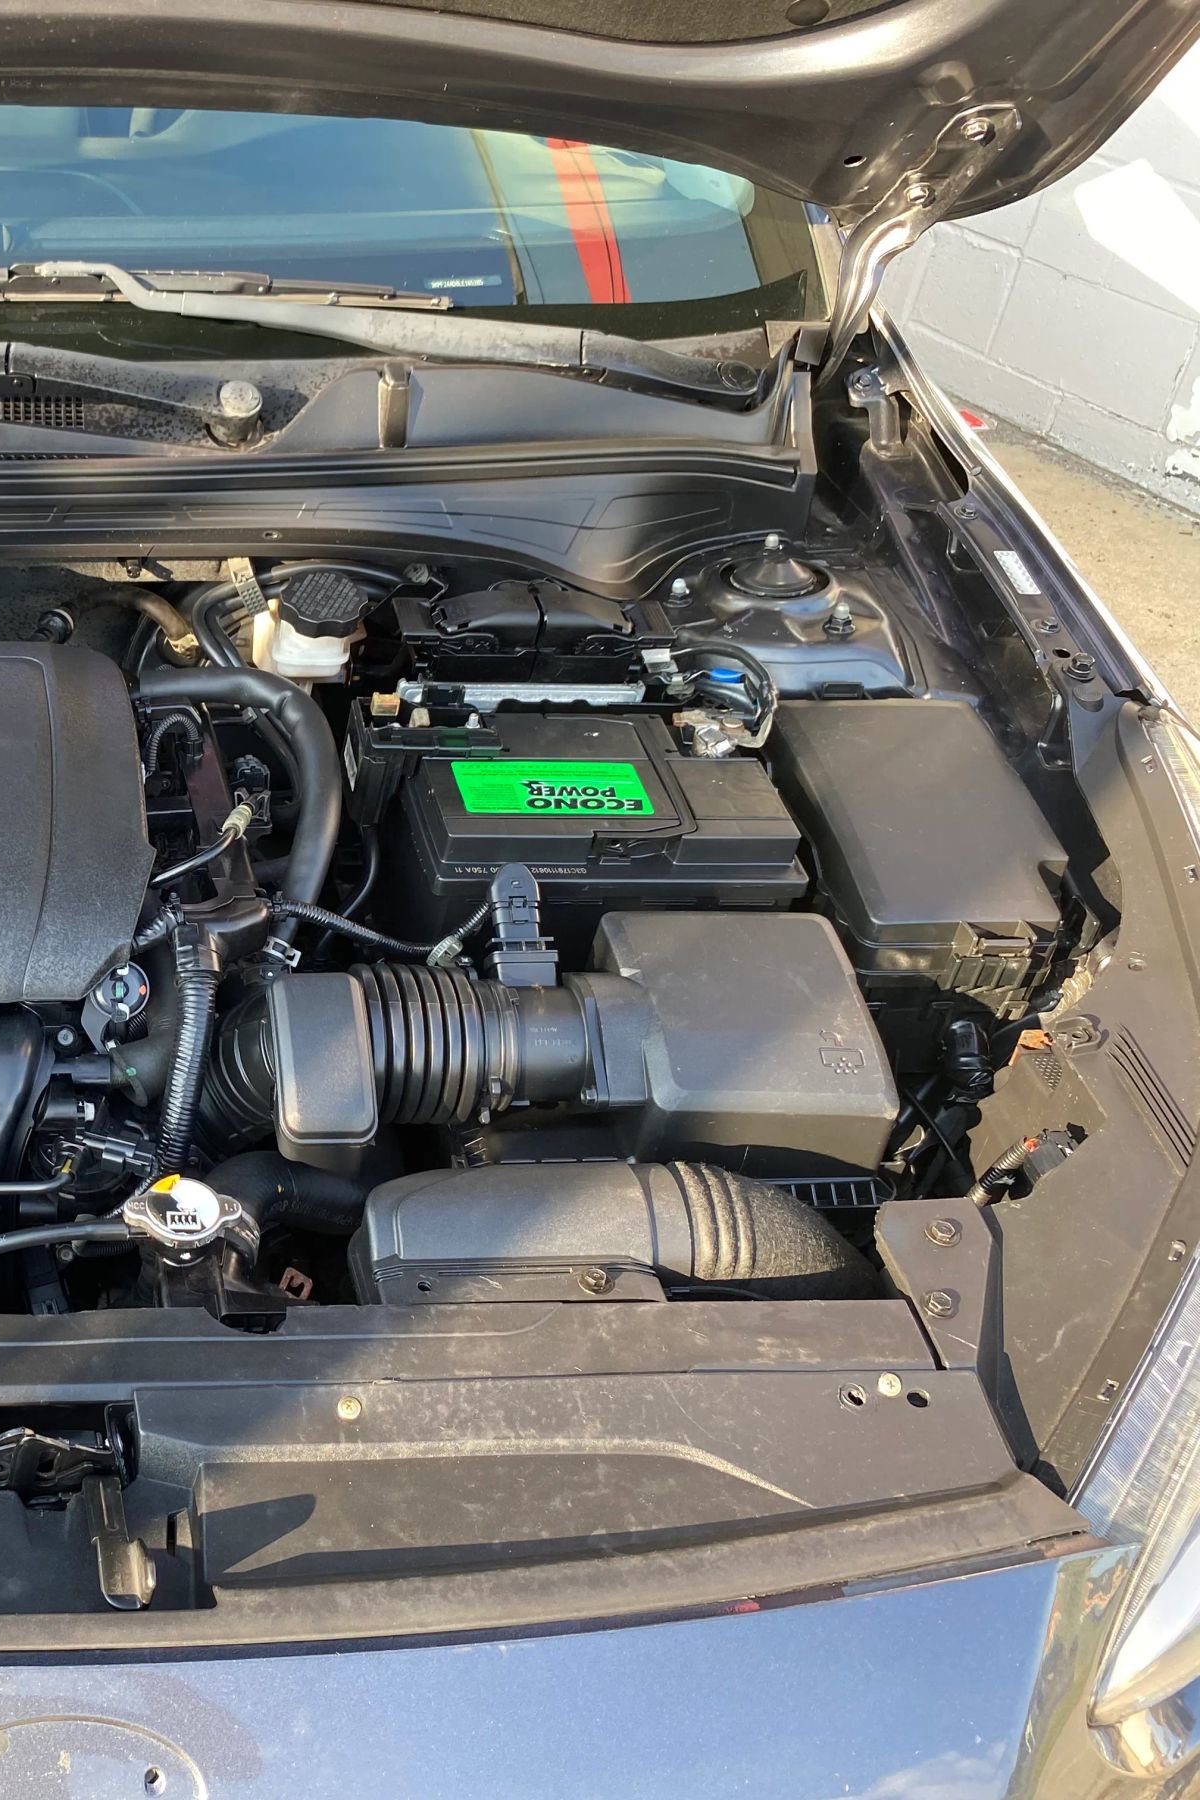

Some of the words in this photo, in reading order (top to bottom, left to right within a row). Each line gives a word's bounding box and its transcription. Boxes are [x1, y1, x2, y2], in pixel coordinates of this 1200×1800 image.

[528, 785, 616, 797] POWER
[526, 797, 643, 810] ECONO
[465, 866, 488, 874] 750A
[224, 1203, 238, 1212] 1.1
